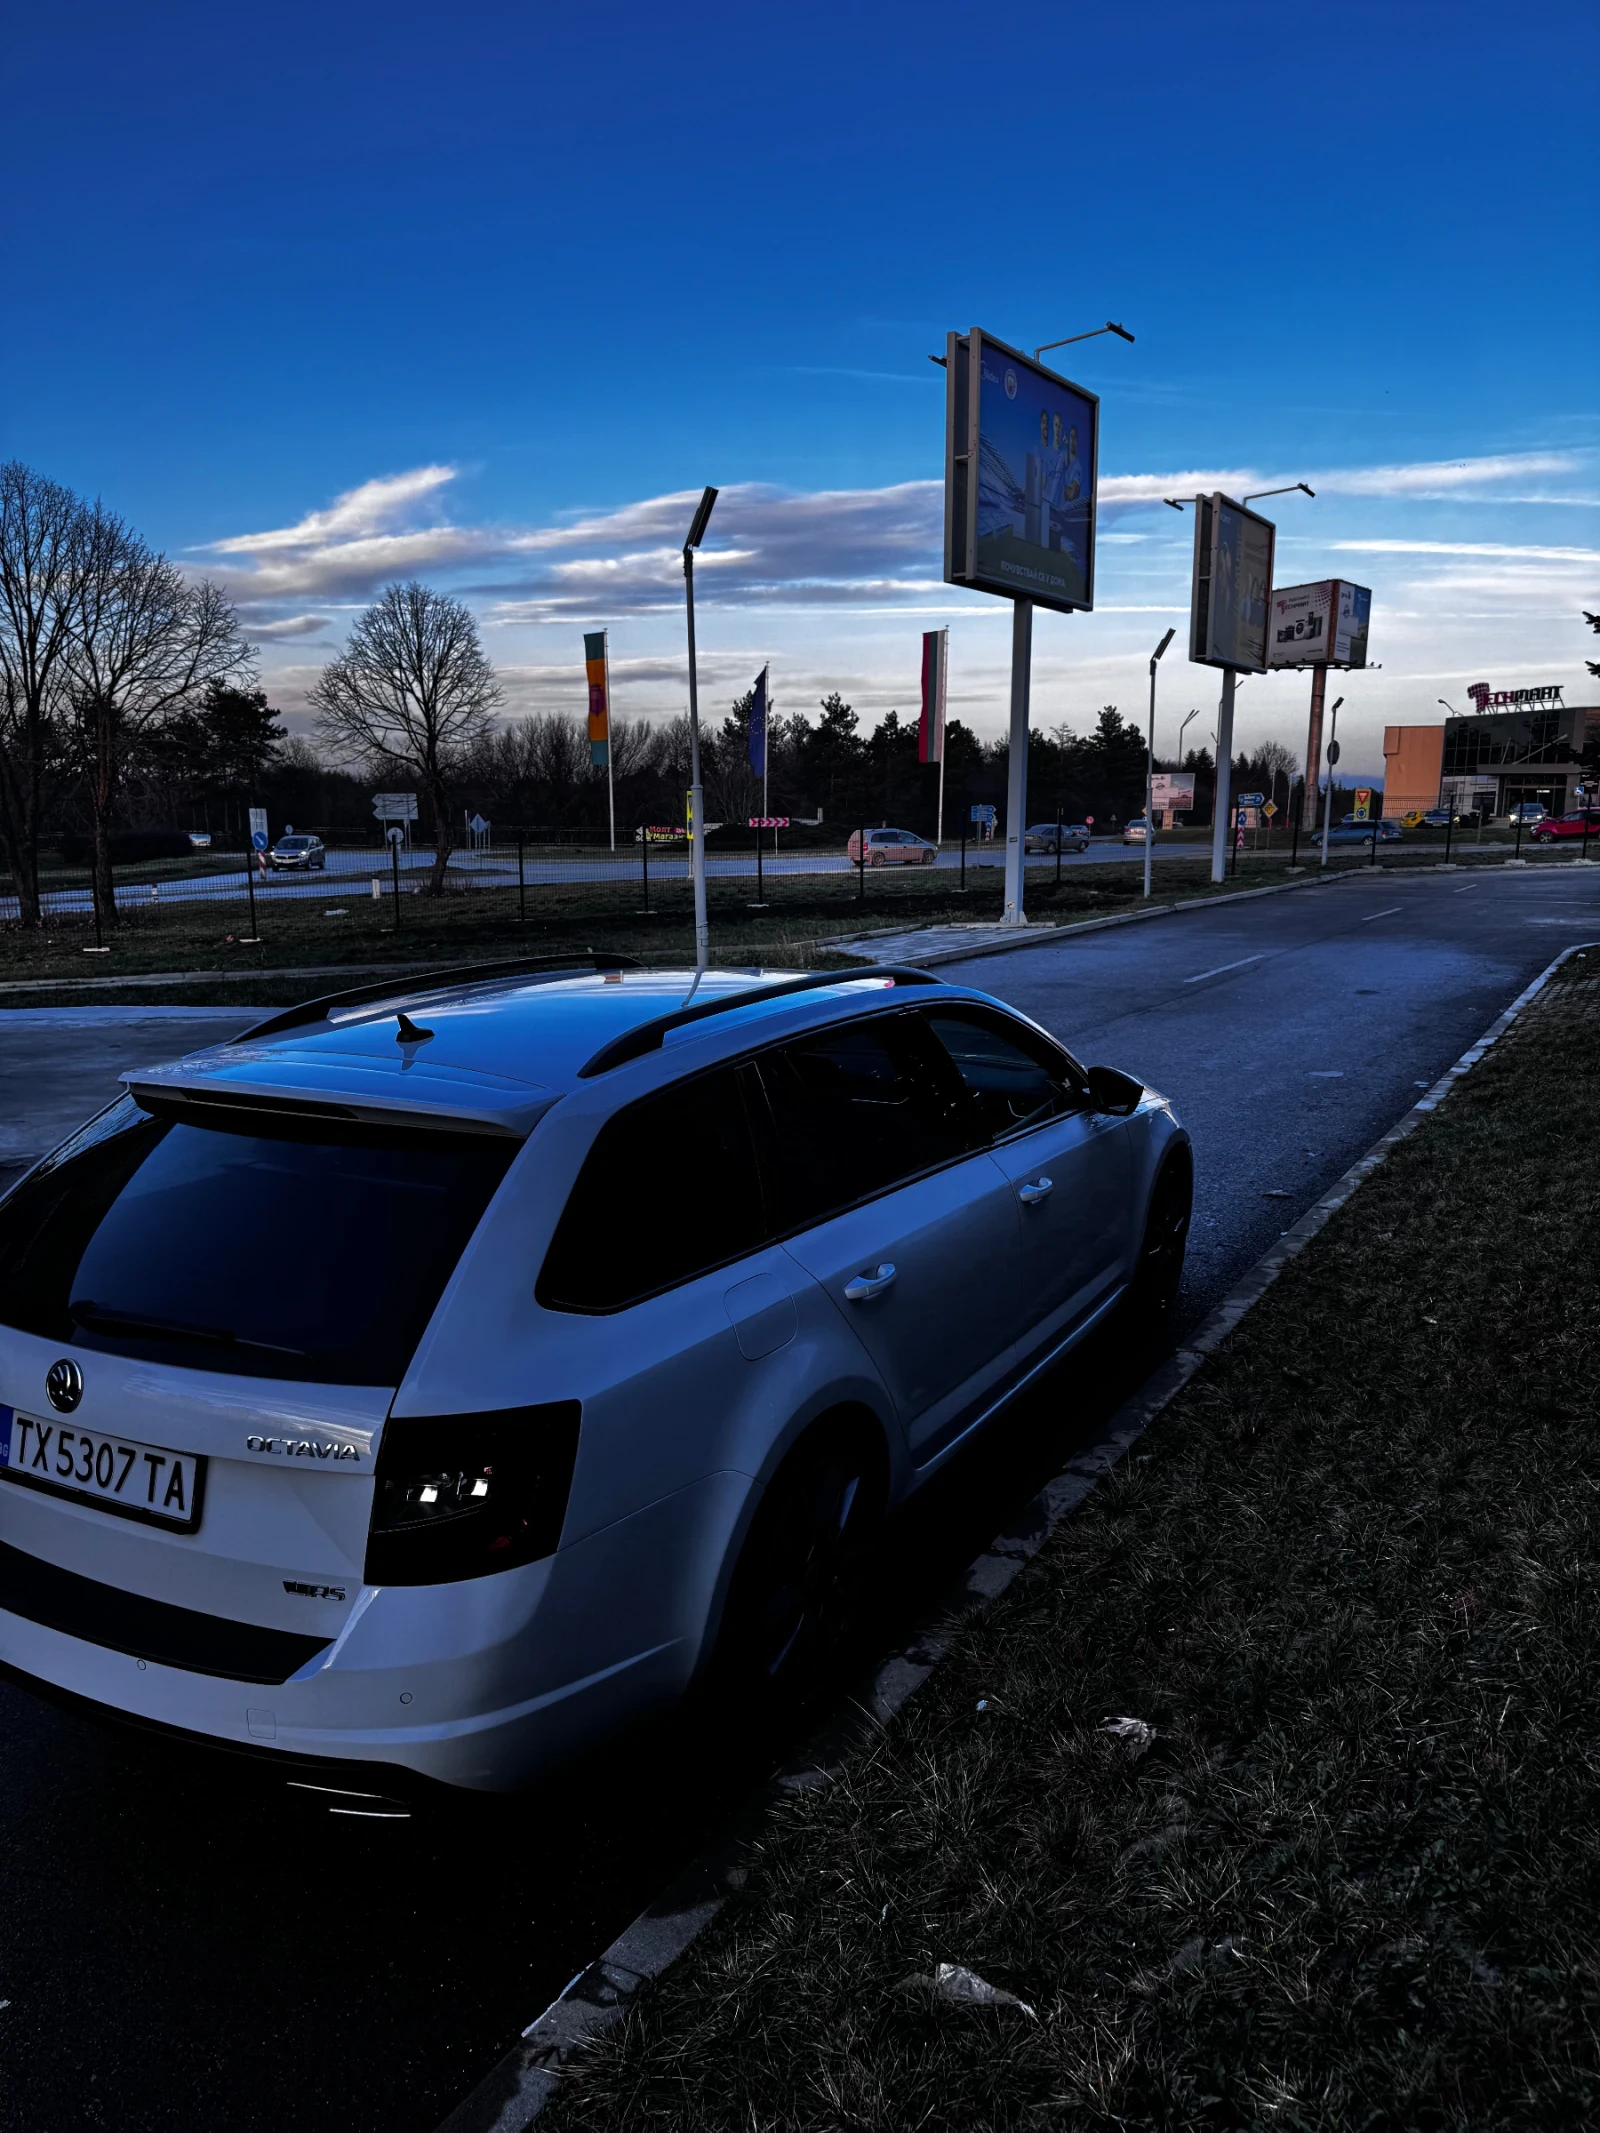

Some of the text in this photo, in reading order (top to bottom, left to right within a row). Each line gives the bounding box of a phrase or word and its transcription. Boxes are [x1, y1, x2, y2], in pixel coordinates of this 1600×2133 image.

[1467, 682, 1564, 713] TECHMART
[56, 1432, 136, 1492] 5307
[246, 1435, 361, 1461] OCTAVIA
